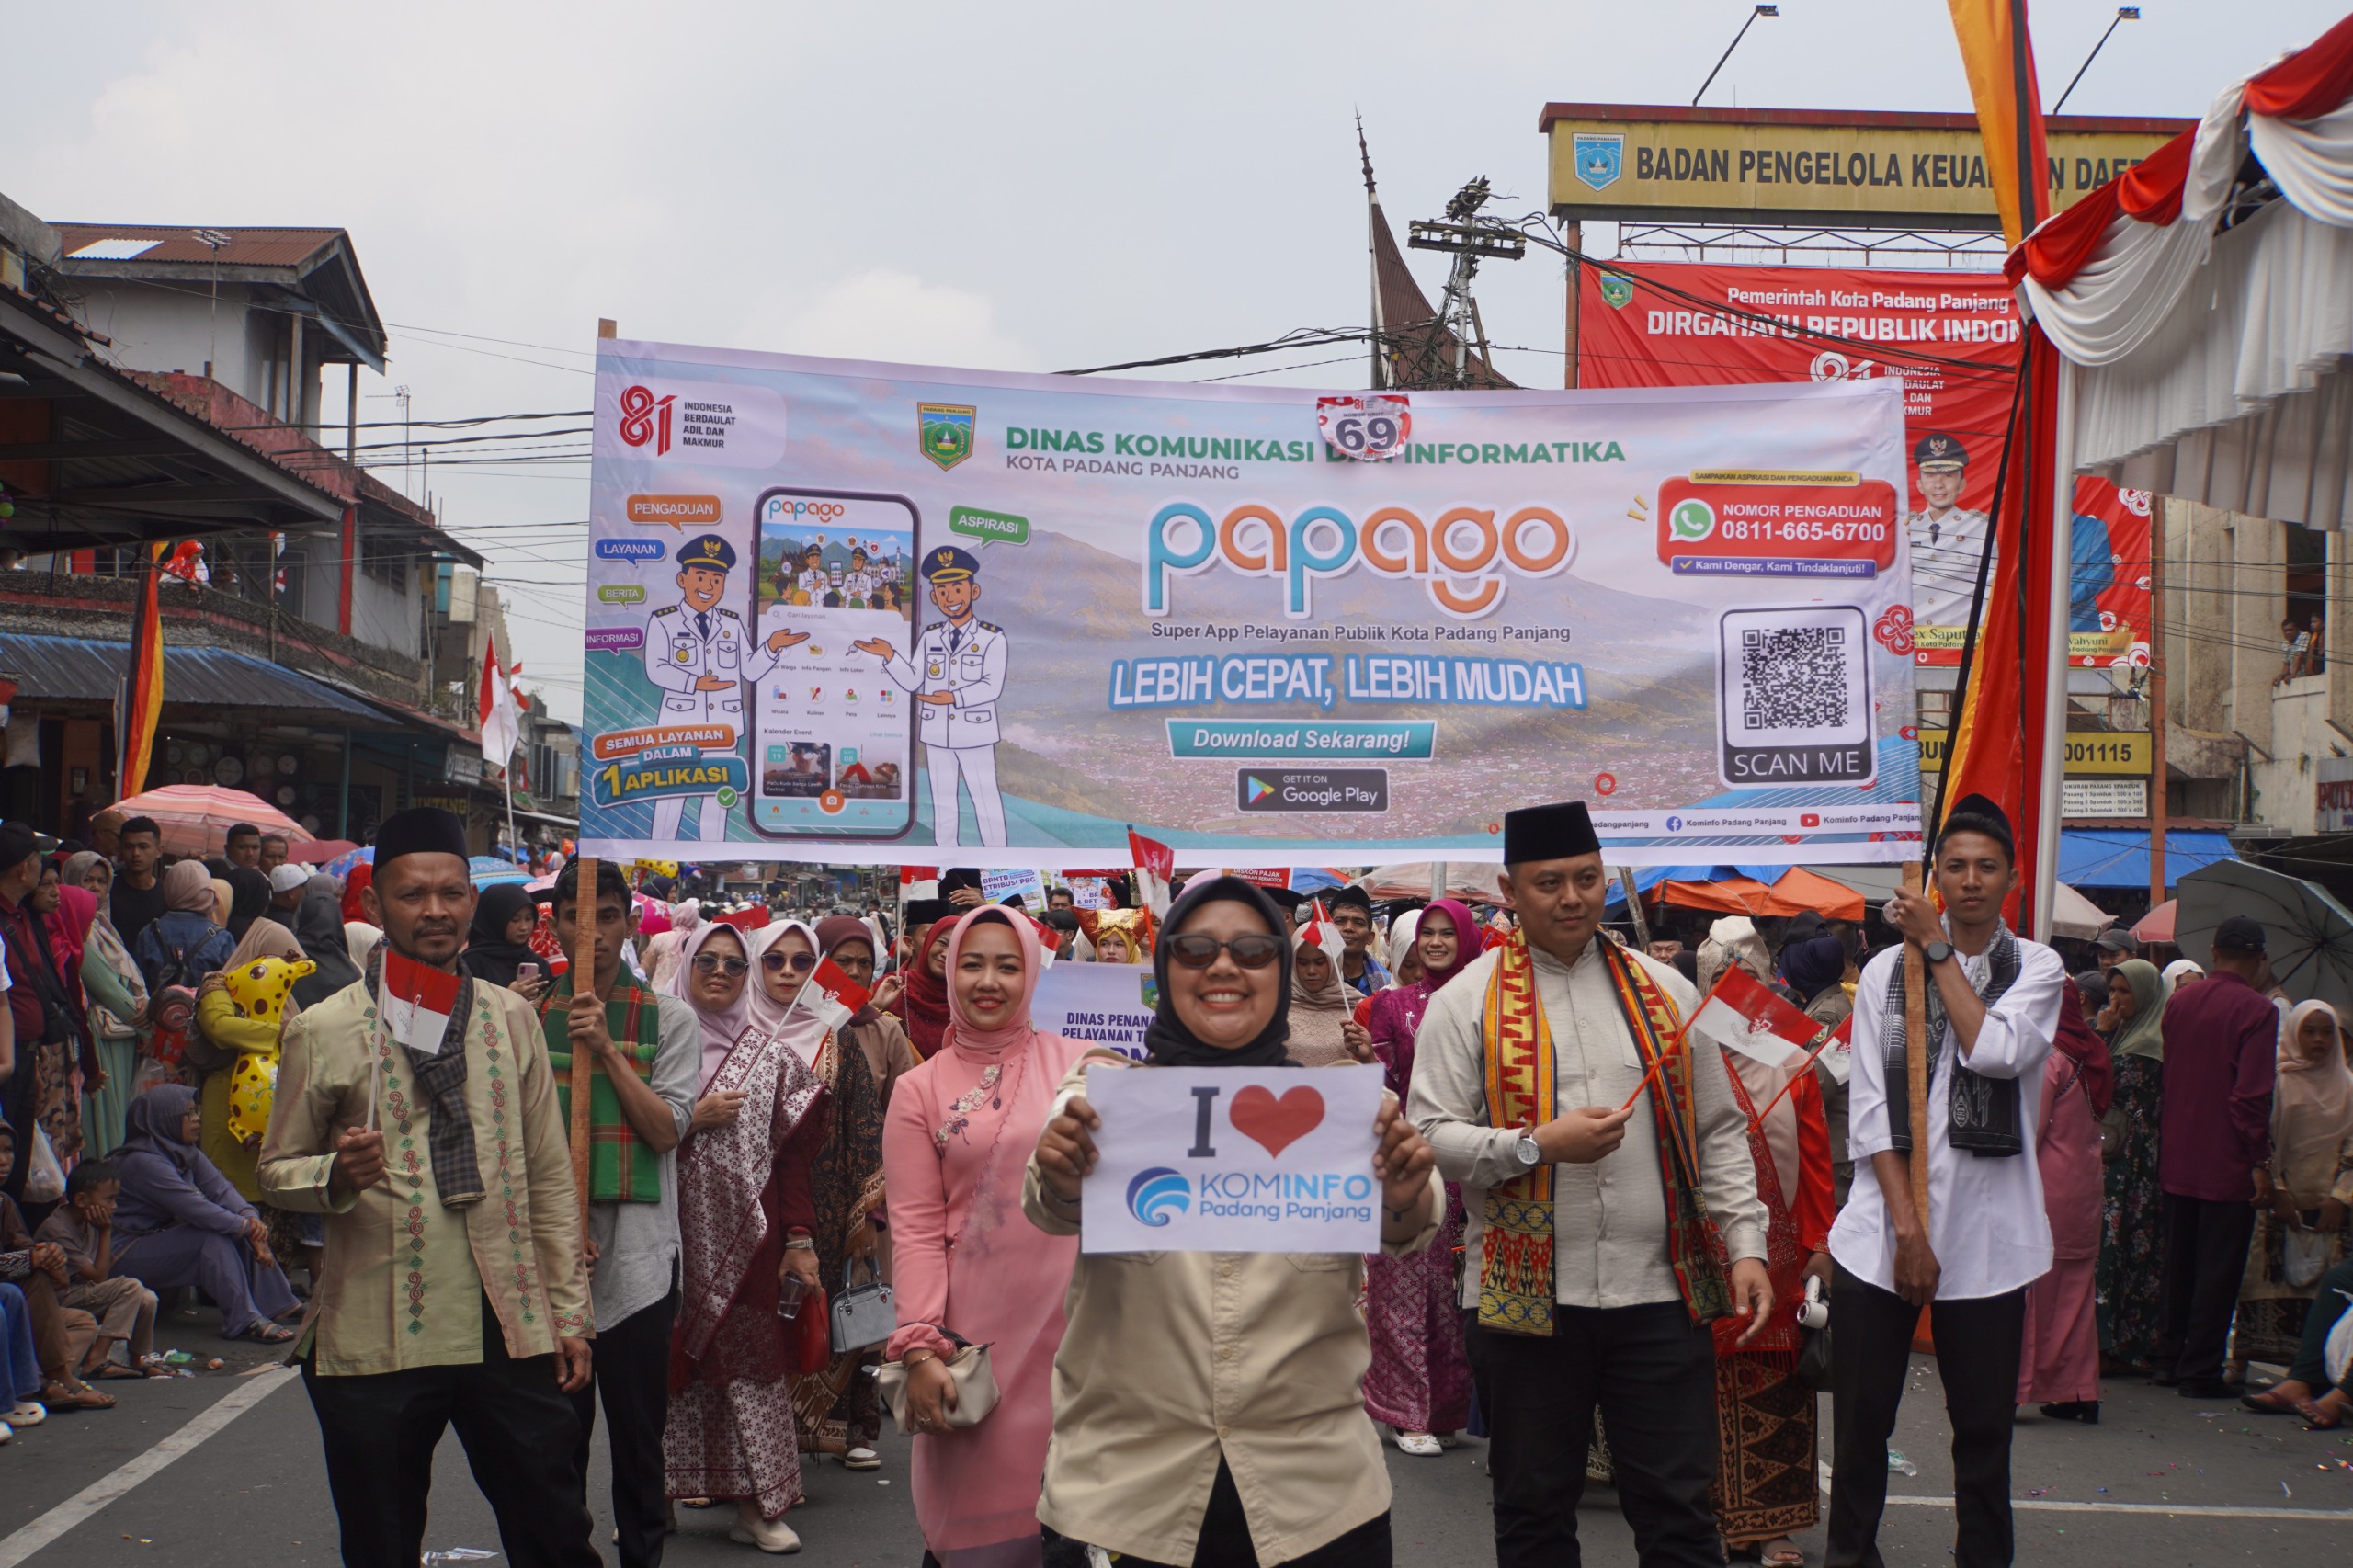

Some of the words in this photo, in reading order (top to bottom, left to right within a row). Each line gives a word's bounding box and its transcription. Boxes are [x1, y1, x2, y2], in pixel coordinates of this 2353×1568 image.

[1637, 147, 1729, 182] BADAN
[1739, 150, 1903, 187] PENGELOLA
[1912, 153, 2064, 189] KEUAN
[1727, 287, 1825, 306] Pemerintah
[1831, 291, 1868, 307] Kota
[1872, 291, 1936, 312] Padang
[1940, 293, 2009, 313] Panjang
[1647, 311, 1800, 339] DIRGAHAYU
[1807, 315, 1937, 341] REPUBLIK
[1884, 366, 1941, 376] INDONESIA
[1910, 392, 1932, 403] DAN
[684, 402, 733, 414] INDONESIA
[620, 385, 678, 457] 81
[684, 414, 736, 426] BERDAULAT
[683, 426, 704, 435] ADIL
[705, 426, 725, 437] DAN
[1336, 417, 1397, 451] 69
[683, 437, 724, 449] MAKMUR
[1006, 426, 1104, 454] DINAS
[1115, 433, 1313, 462] KOMUNIKASI
[1404, 441, 1626, 464] INFORMATIKA
[1006, 455, 1057, 472] KOTA
[1063, 459, 1143, 476] PADANG
[1150, 463, 1240, 480] PANJANG
[634, 503, 714, 516] PENGADUAN
[769, 500, 845, 523] papago
[1723, 504, 1780, 517] NOMOR
[1784, 506, 1881, 517] PENGADUAN
[958, 514, 1019, 534] ASPIRASI
[1722, 520, 1884, 541] 0811-665-6700
[603, 544, 657, 555] LAYANAN
[1149, 502, 1570, 613] papago
[1695, 561, 1722, 570] Kami
[1724, 561, 1764, 573] Dengar,
[1767, 562, 1792, 572] Kami
[1796, 562, 1865, 574] Tindaklanjuti!
[606, 589, 639, 597] BERITA
[586, 633, 639, 643] INFORMASI
[1151, 622, 1200, 641] Super
[1204, 623, 1239, 642] App
[1244, 624, 1329, 642] Pelayanan
[1335, 625, 1385, 641] Publik
[1391, 626, 1428, 641] Kota
[1435, 626, 1497, 642] Padang
[1503, 626, 1571, 642] Panjang
[1113, 659, 1213, 706] LEBIH
[1222, 658, 1332, 706] CEPAT,
[1348, 658, 1448, 699] LEBIH
[1454, 661, 1583, 705] MUDAH
[606, 734, 655, 751] SEMUA
[658, 729, 723, 744] LAYANAN
[1193, 729, 1299, 749] Download
[1304, 730, 1411, 753] Sekarang!
[643, 746, 692, 761] DALAM
[1733, 753, 1807, 777] SCAN
[1820, 750, 1860, 774] ME
[602, 764, 621, 796] 1
[624, 767, 729, 791] APLIKASI
[1283, 775, 1302, 783] GET
[1282, 786, 1342, 806] Google
[1346, 787, 1378, 805] Play
[1722, 818, 1752, 827] Padang
[1754, 817, 1787, 826] Panjang
[1860, 815, 1891, 824] Padang
[983, 874, 1009, 884] BPHTB
[1233, 868, 1258, 876] DISKON
[1259, 869, 1280, 878] PAJAK
[1067, 1012, 1105, 1026] DINAS
[1062, 1028, 1132, 1042] PELAYANAN
[1188, 1086, 1220, 1158] I
[1200, 1173, 1371, 1200] KOMINFO
[1199, 1200, 1279, 1221] Padang
[1286, 1202, 1371, 1222] Panjang
